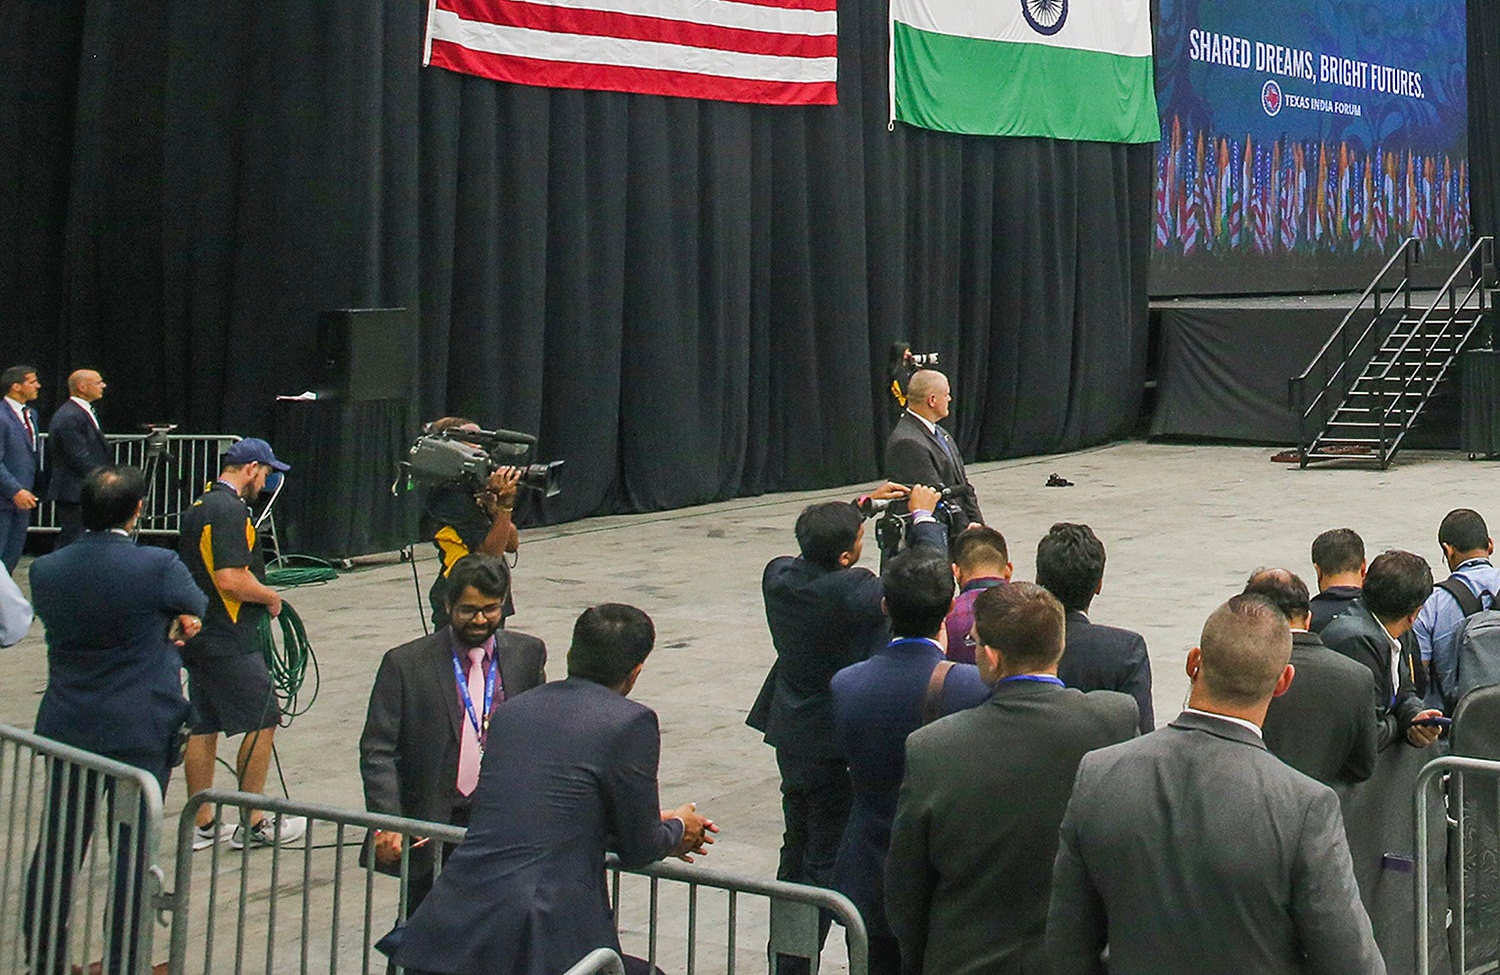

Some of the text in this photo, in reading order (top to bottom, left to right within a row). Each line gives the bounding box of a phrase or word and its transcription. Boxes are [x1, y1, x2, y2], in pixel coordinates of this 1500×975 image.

[1189, 28, 1425, 99] SHARED DREAMS, BRIGHT FUTURES.
[1285, 93, 1361, 117] TEXAS INDIA FORUM
